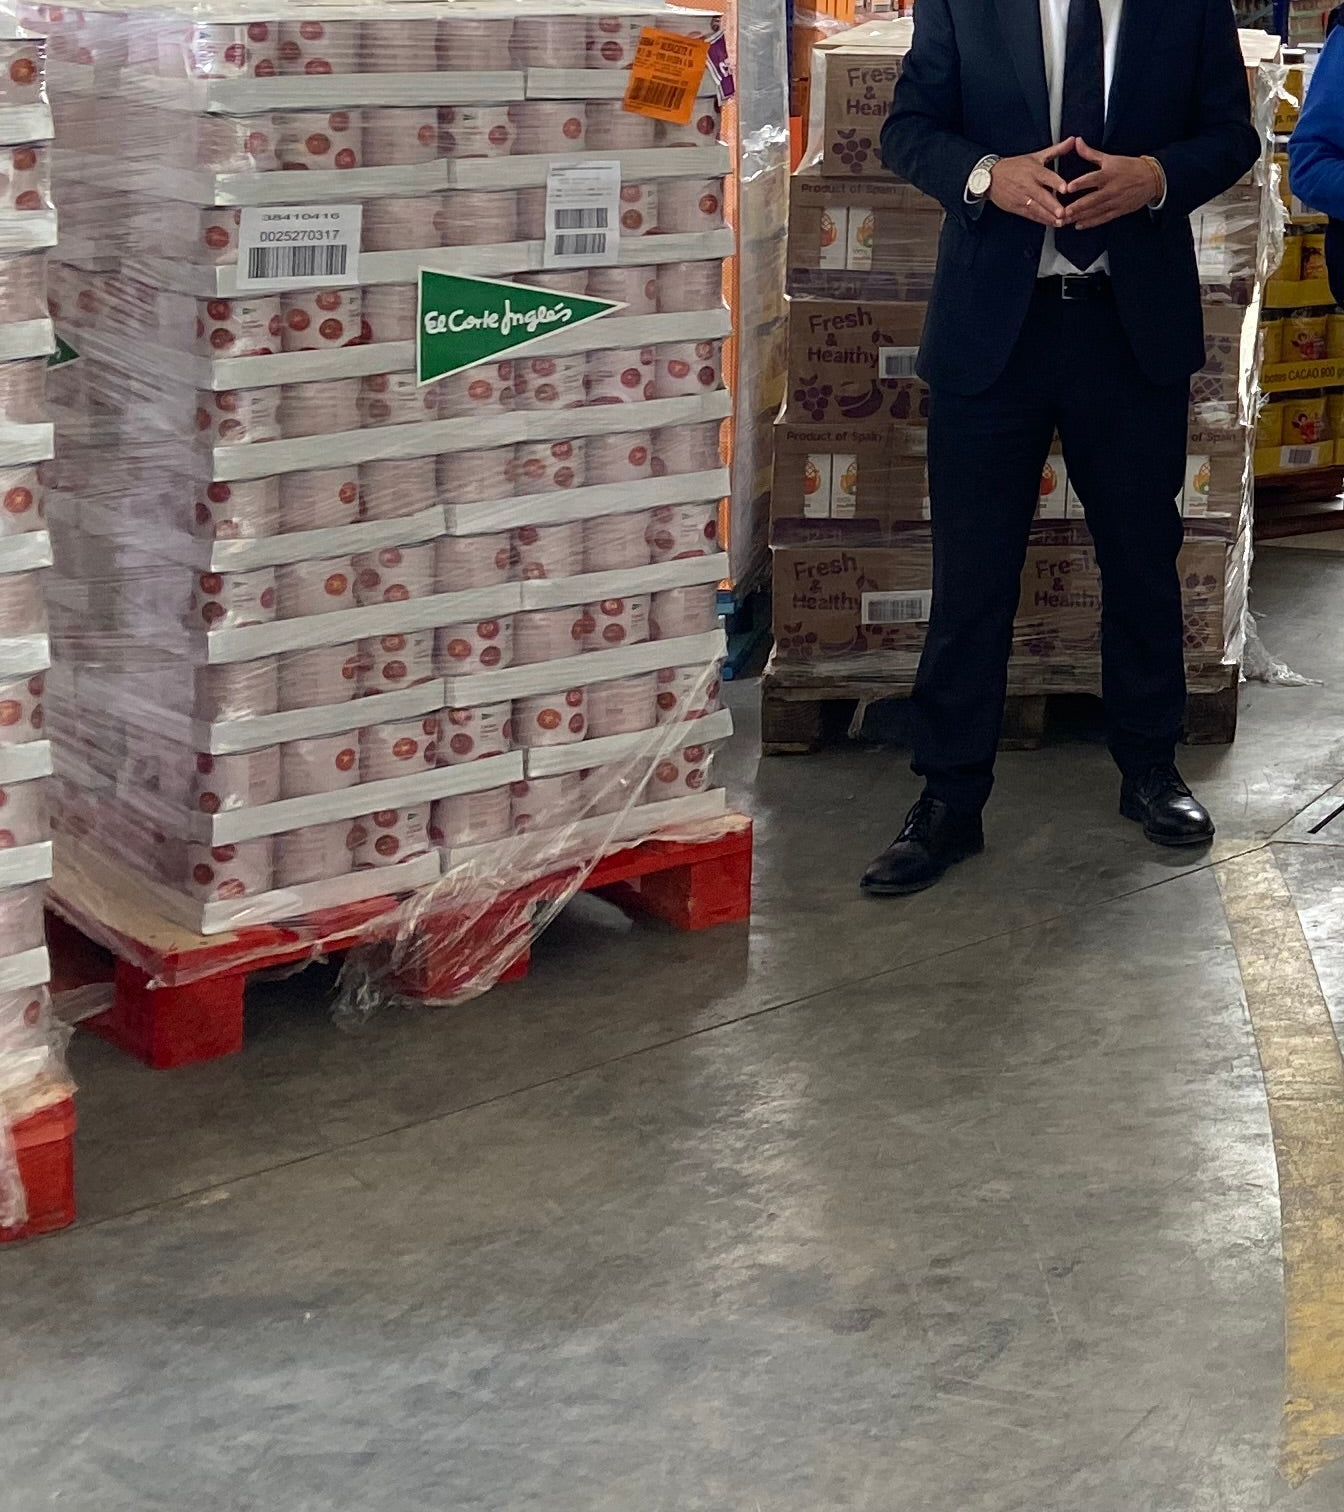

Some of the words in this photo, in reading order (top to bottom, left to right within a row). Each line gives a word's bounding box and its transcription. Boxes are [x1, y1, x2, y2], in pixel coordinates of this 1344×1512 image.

[259, 230, 341, 242] 0025270317
[424, 312, 446, 334] El
[448, 306, 499, 332] Corte
[500, 299, 574, 336] Inglés
[808, 306, 873, 334] Fresh
[825, 333, 838, 347] &
[807, 346, 878, 368] Healthy
[786, 430, 832, 441] Product
[853, 432, 882, 442] Spain
